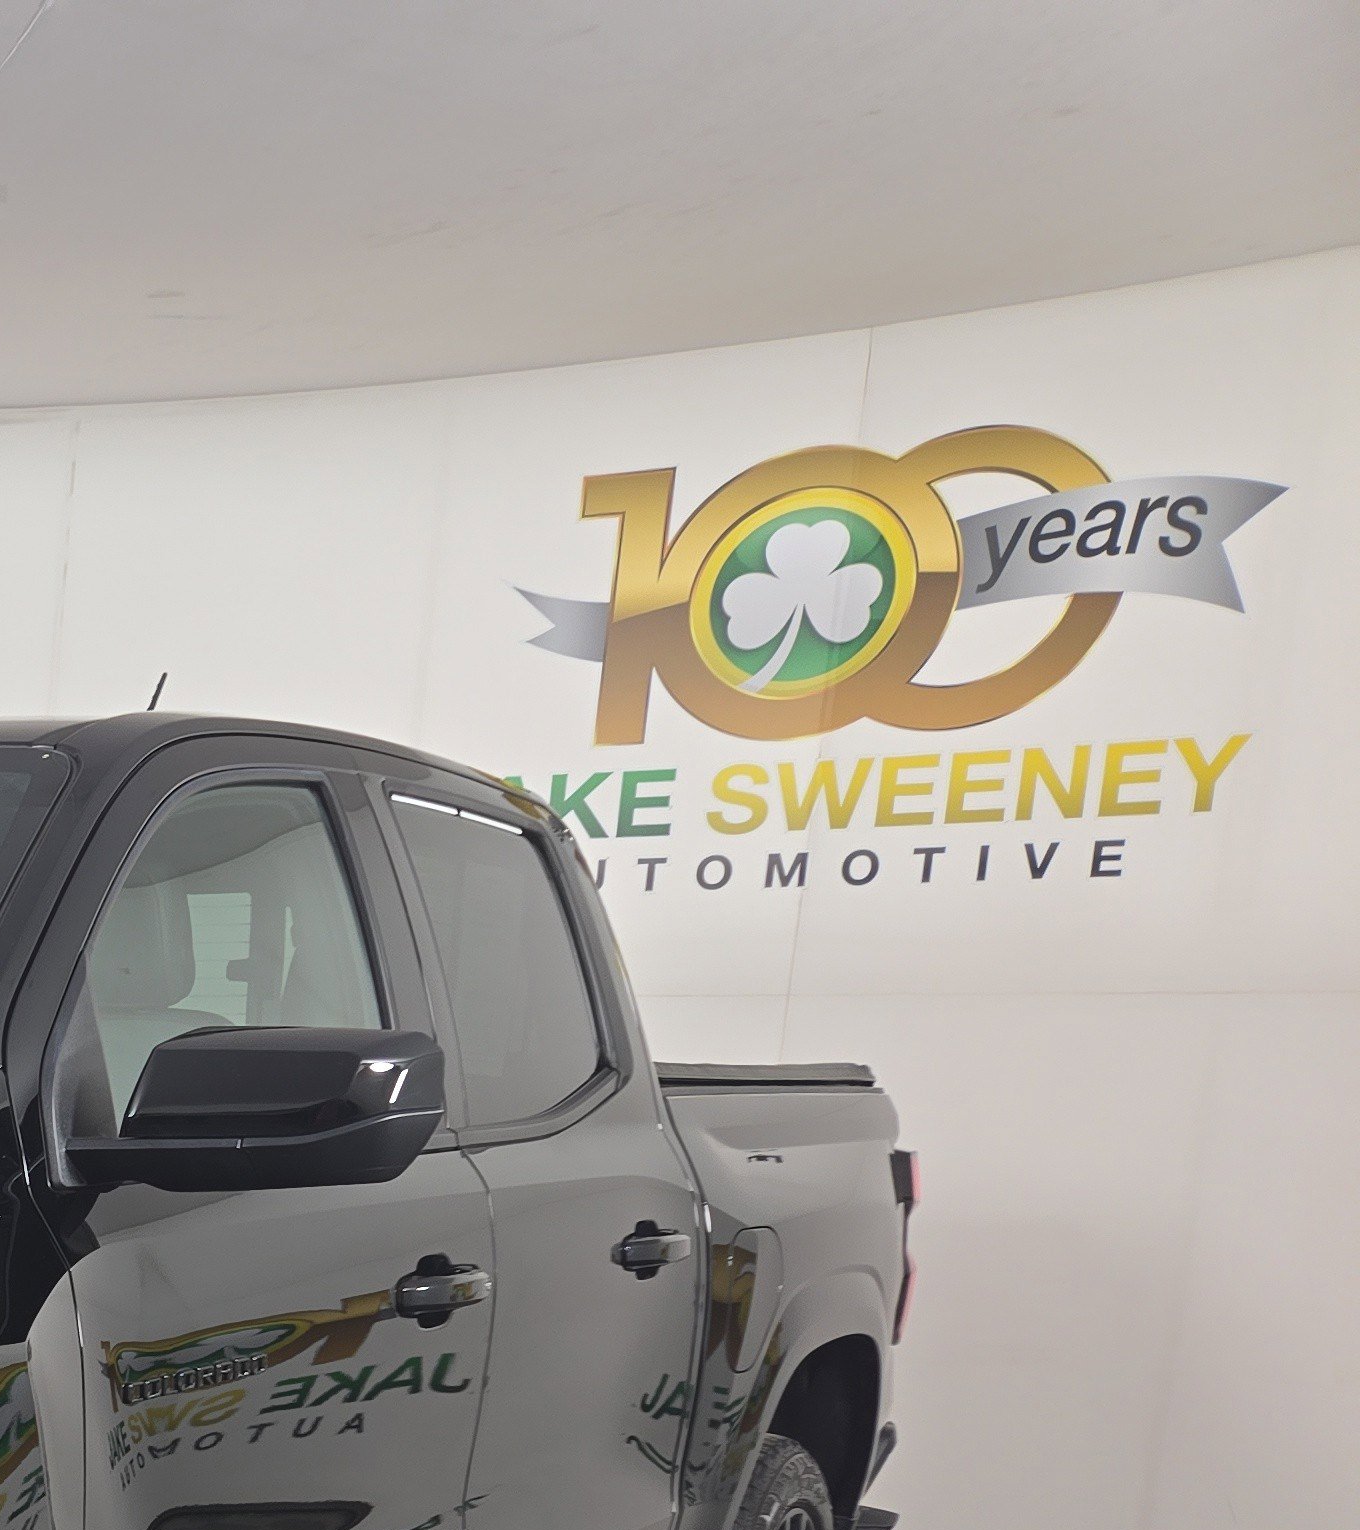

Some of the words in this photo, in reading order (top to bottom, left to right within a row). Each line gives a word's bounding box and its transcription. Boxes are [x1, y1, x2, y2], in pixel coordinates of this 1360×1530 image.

[580, 424, 1126, 747] 100
[977, 495, 1208, 595] years
[502, 768, 677, 838] KE
[706, 734, 1252, 836] SWEENEY
[595, 838, 1127, 892] TOMOTIVE
